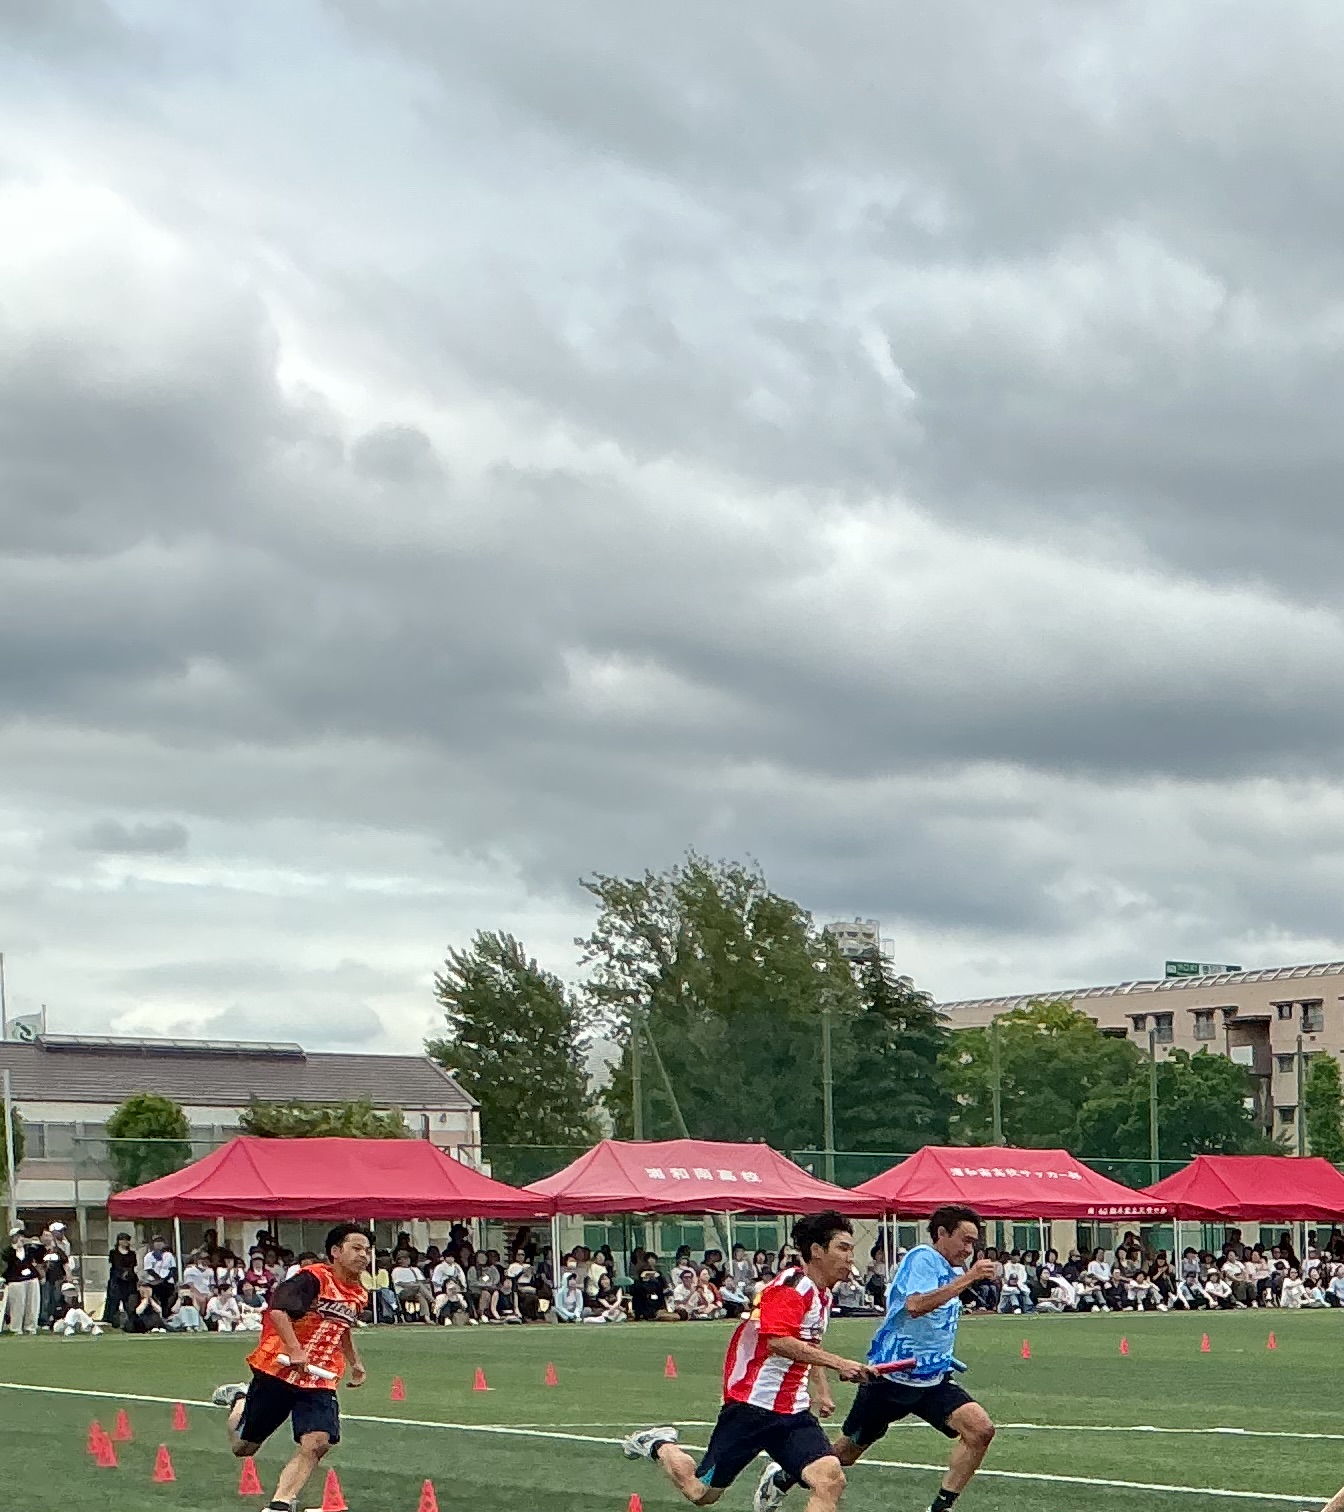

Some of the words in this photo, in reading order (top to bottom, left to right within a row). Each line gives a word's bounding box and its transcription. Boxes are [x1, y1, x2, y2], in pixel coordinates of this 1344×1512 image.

[644, 1167, 763, 1183] 浦和南高校
